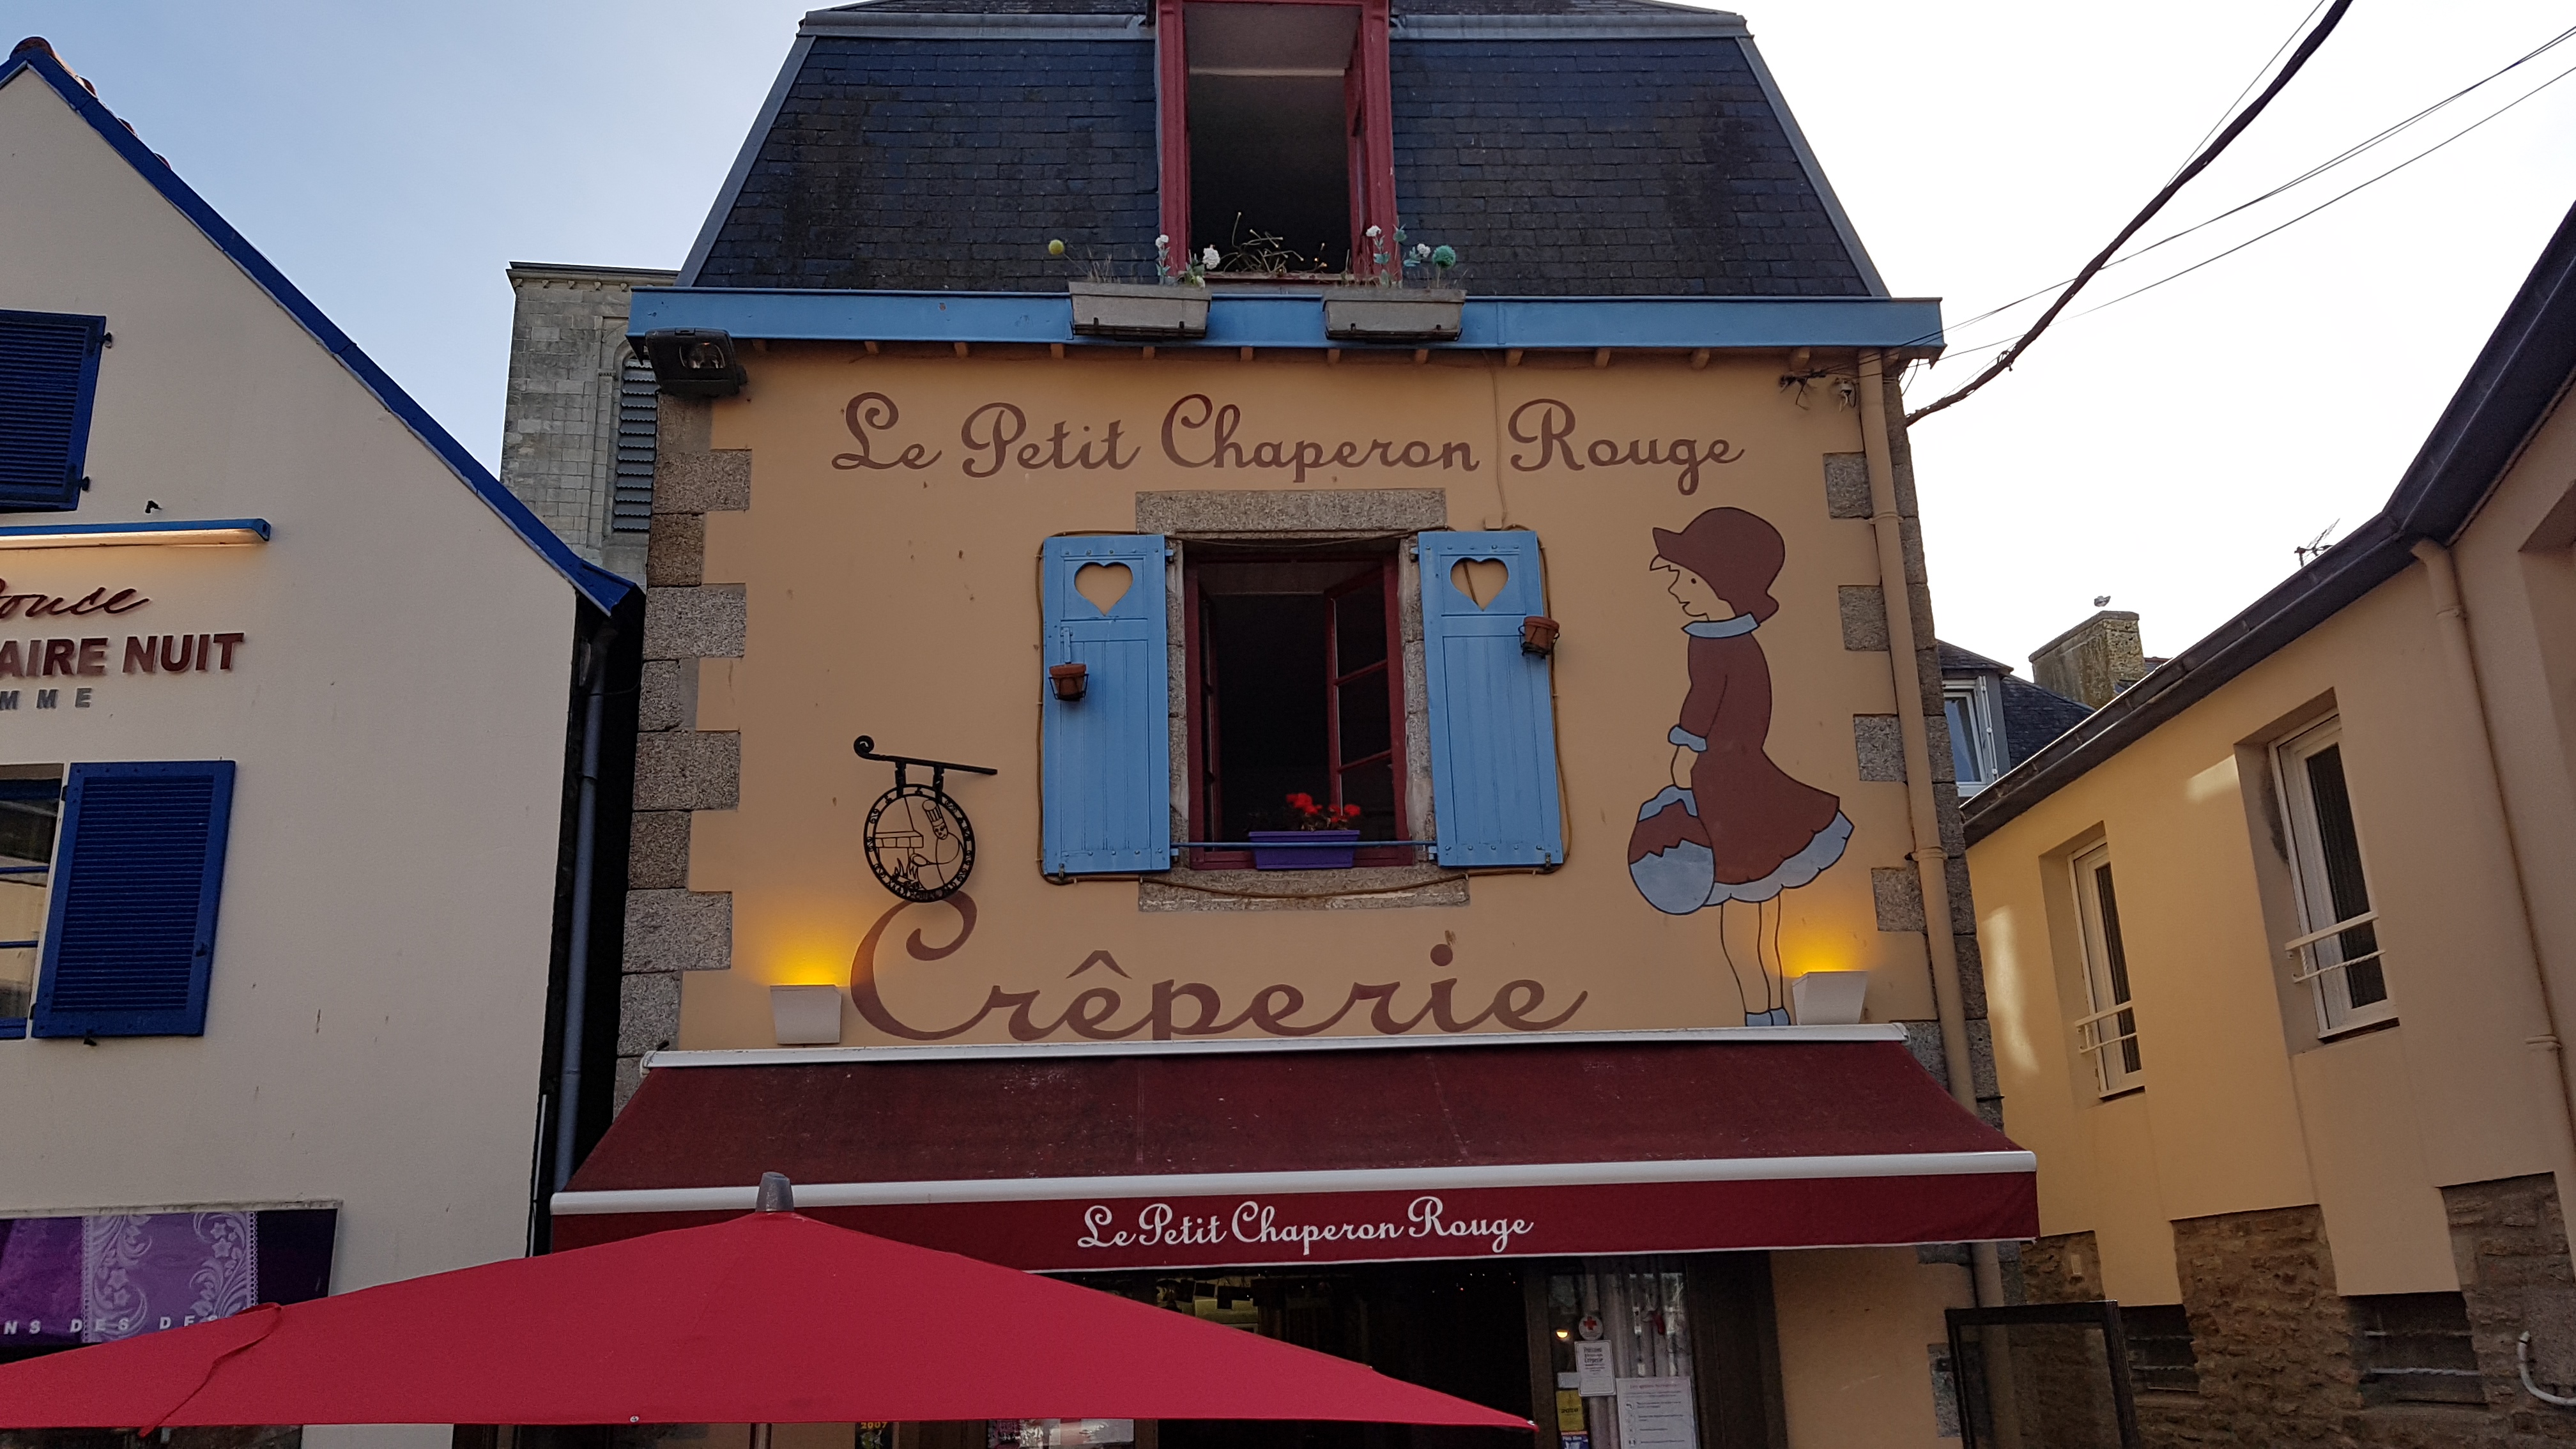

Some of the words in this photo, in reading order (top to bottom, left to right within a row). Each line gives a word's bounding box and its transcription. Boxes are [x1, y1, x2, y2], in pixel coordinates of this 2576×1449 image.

[831, 392, 942, 470] Le
[961, 402, 1141, 478] Petit
[1161, 394, 1480, 483] Chaperon
[1508, 398, 1745, 496] Rouge
[0, 578, 150, 619] ouce
[122, 632, 245, 673] NUIT
[850, 892, 1589, 1041] Crêperie
[1077, 1206, 1136, 1248] Le
[1138, 1203, 1227, 1246] Petit
[1231, 1201, 1404, 1256] Chaperon
[1407, 1196, 1533, 1253] Rouge
[70, 1317, 130, 1333] DES
